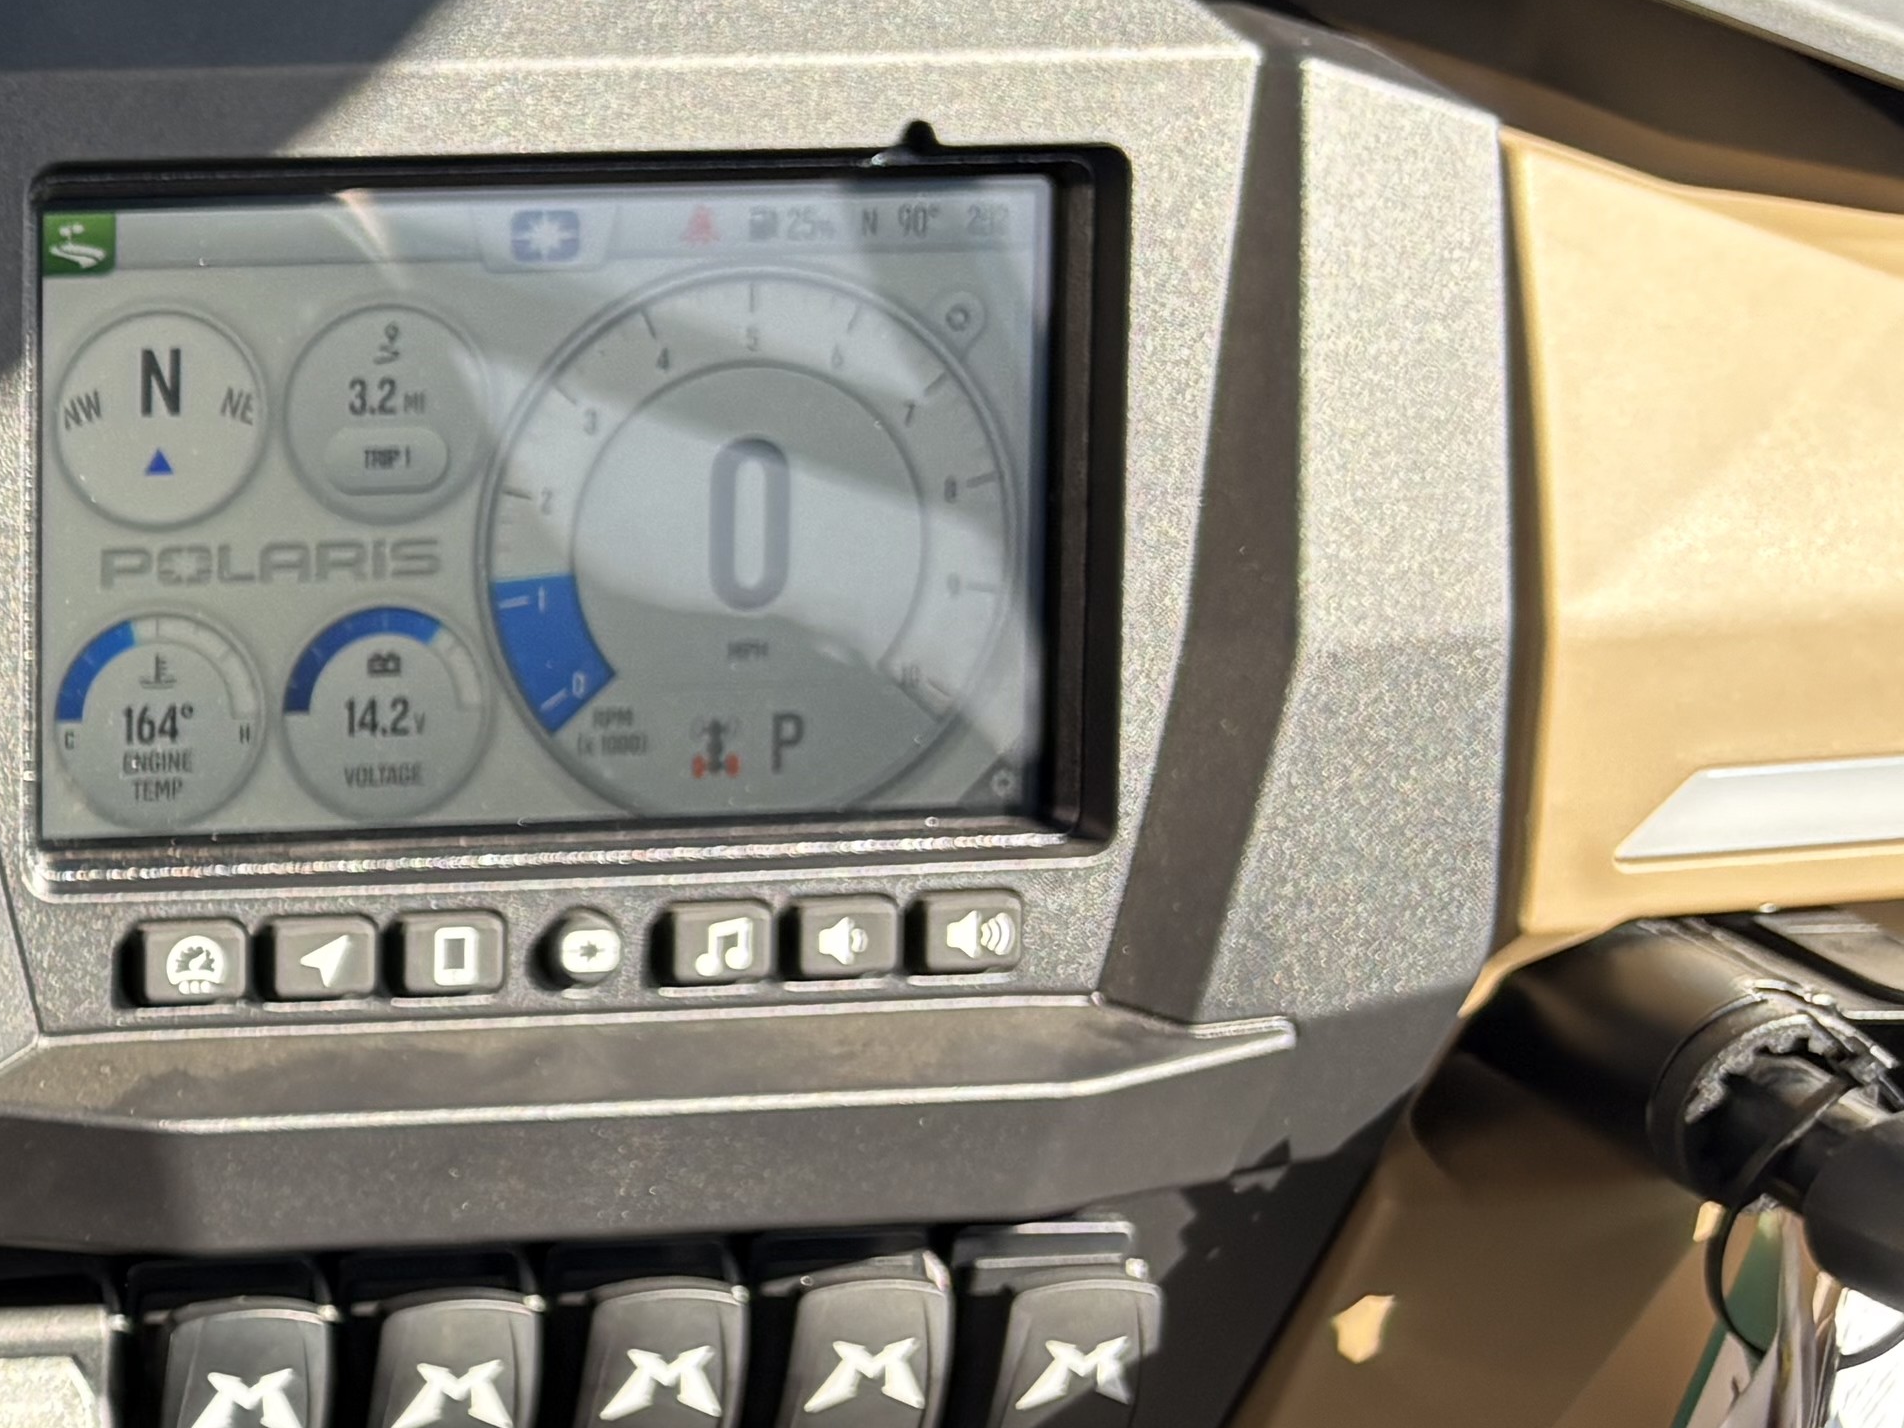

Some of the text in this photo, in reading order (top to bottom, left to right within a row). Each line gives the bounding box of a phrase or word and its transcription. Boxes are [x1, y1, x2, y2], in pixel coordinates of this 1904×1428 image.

[656, 347, 670, 372] 4
[62, 347, 254, 431] NW N NE
[348, 377, 398, 416] 3.2
[709, 437, 789, 612] 0
[99, 537, 442, 590] POLARIS
[771, 713, 804, 773] P
[133, 780, 184, 802] TEMP
